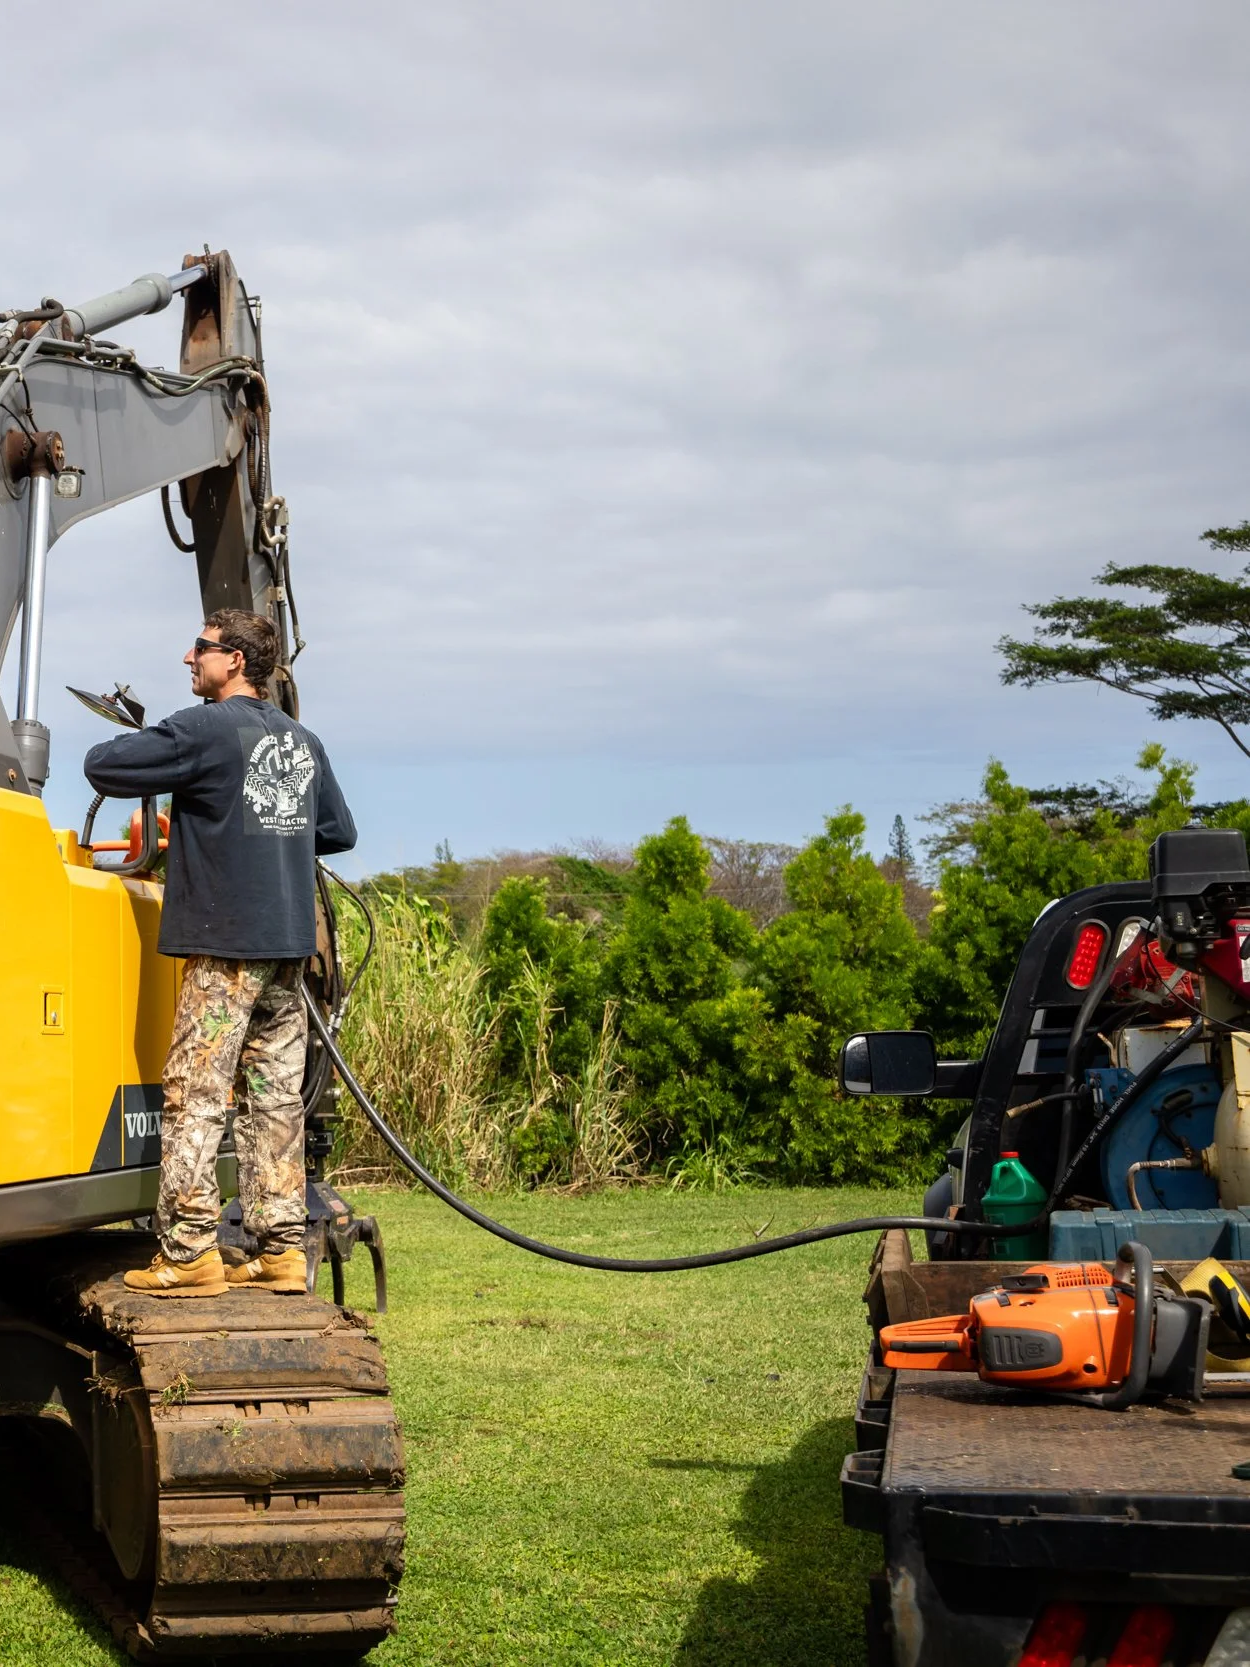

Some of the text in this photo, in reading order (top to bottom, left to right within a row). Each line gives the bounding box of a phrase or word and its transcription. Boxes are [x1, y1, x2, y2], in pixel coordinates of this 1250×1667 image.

[1124, 1081, 1137, 1095] FUEL
[1109, 1097, 1124, 1114] HOSE
[124, 1111, 163, 1138] VOLV
